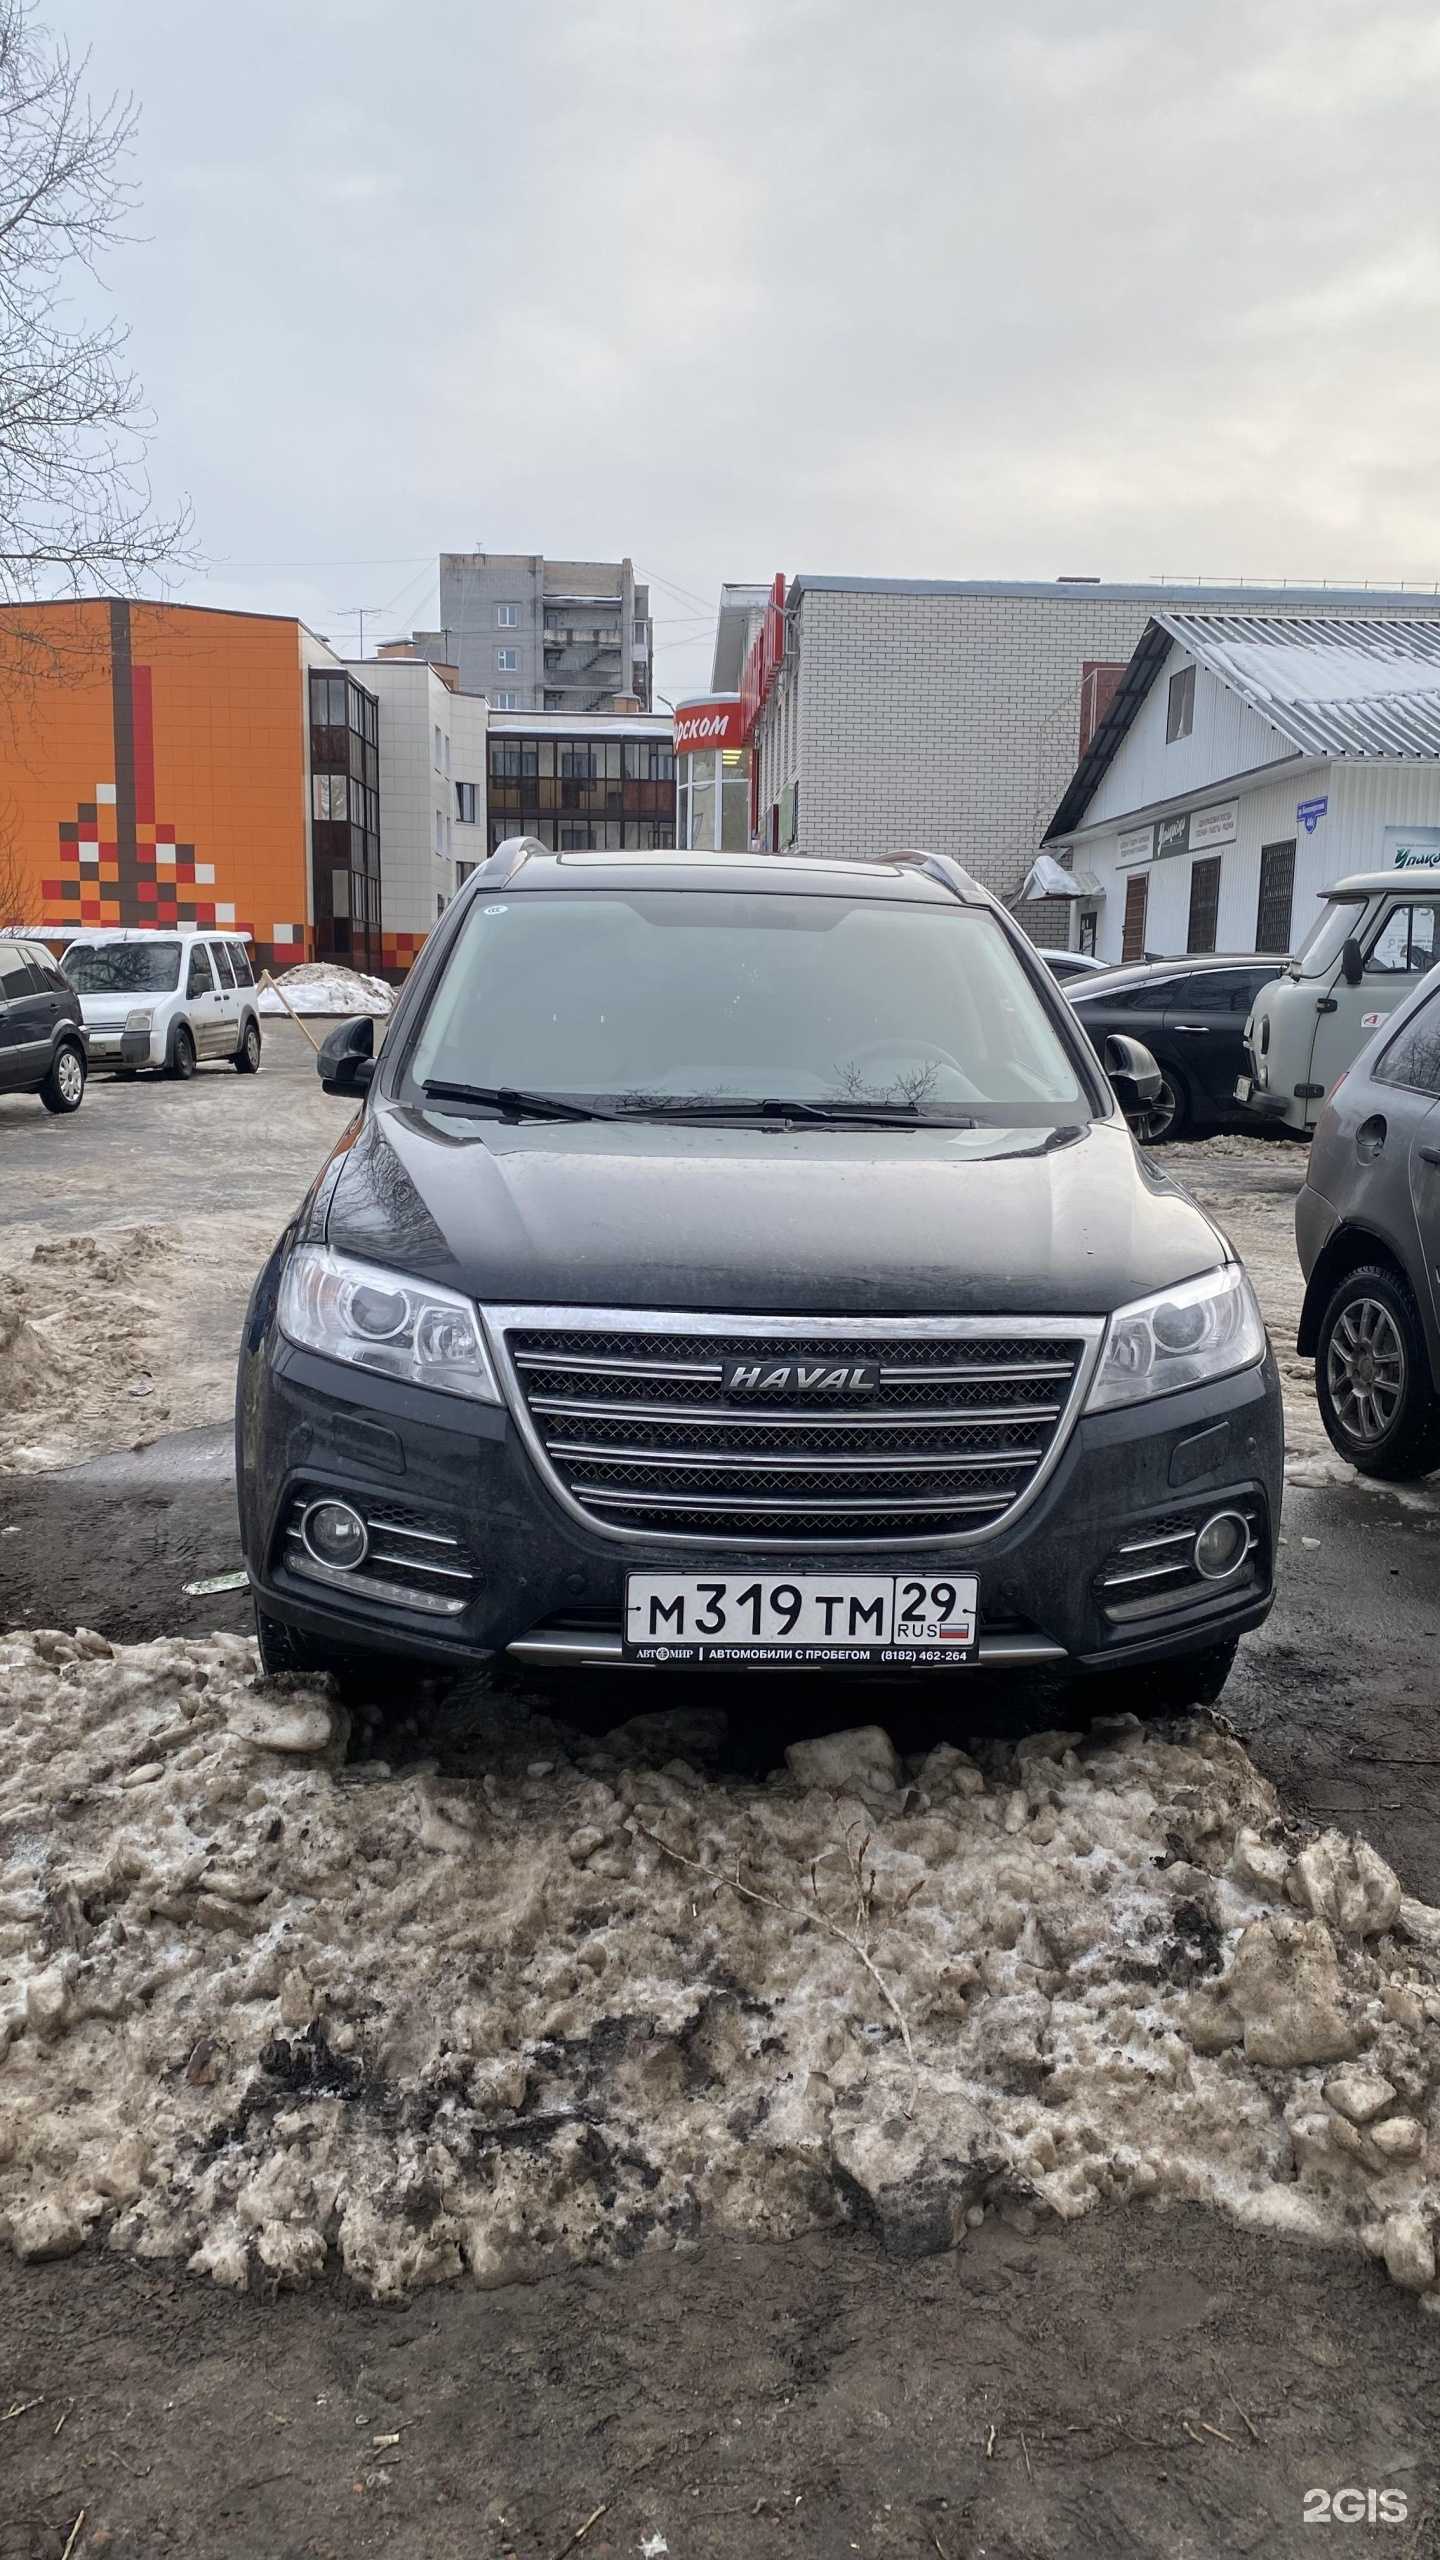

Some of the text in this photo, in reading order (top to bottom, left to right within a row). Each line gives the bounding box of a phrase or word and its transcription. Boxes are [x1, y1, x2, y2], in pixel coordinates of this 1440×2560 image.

[729, 1367, 874, 1389] HAVAL
[901, 1582, 957, 1622] 29
[897, 1623, 937, 1638] RUS
[708, 1649, 793, 1660] АВТОМОБИЛИ
[794, 1649, 804, 1660] С
[805, 1649, 871, 1661] ПРОБЕГОМ
[880, 1650, 917, 1662] (8182)
[918, 1651, 967, 1662] 462-264
